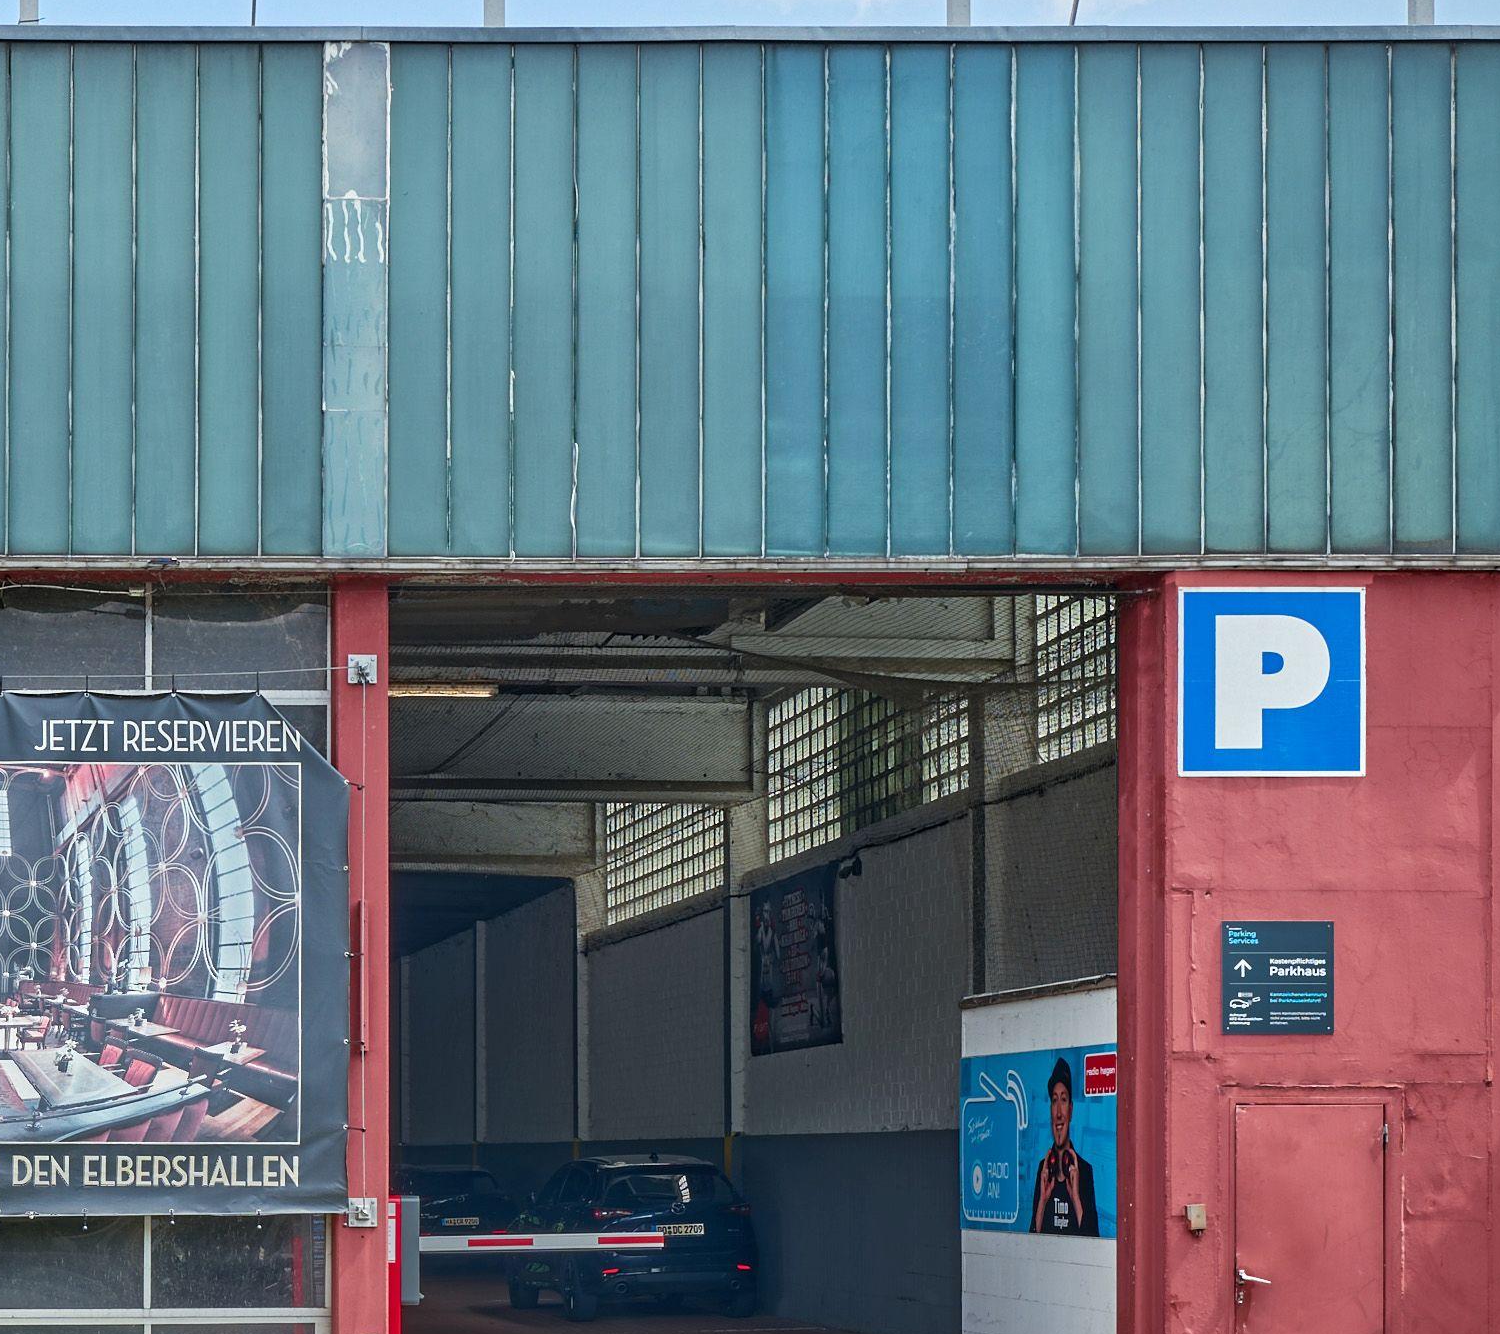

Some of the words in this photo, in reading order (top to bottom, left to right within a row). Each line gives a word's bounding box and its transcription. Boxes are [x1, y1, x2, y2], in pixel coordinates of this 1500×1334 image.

[1214, 614, 1331, 750] P
[34, 719, 114, 752] JETZT
[123, 719, 302, 753] RESERVIEREN
[1228, 930, 1257, 939] Parking
[1269, 958, 1326, 966] Kostenpflichtiges
[1269, 966, 1327, 977] Parkhaus
[1086, 1067, 1099, 1076] radio
[1100, 1067, 1115, 1077] hagen
[11, 1154, 71, 1187] DEN
[82, 1154, 300, 1188] ELBERSHALLEN
[987, 1162, 1009, 1179] RADIO
[1053, 1197, 1069, 1215] Timo
[672, 1225, 683, 1234] DC
[683, 1224, 703, 1234] 2709
